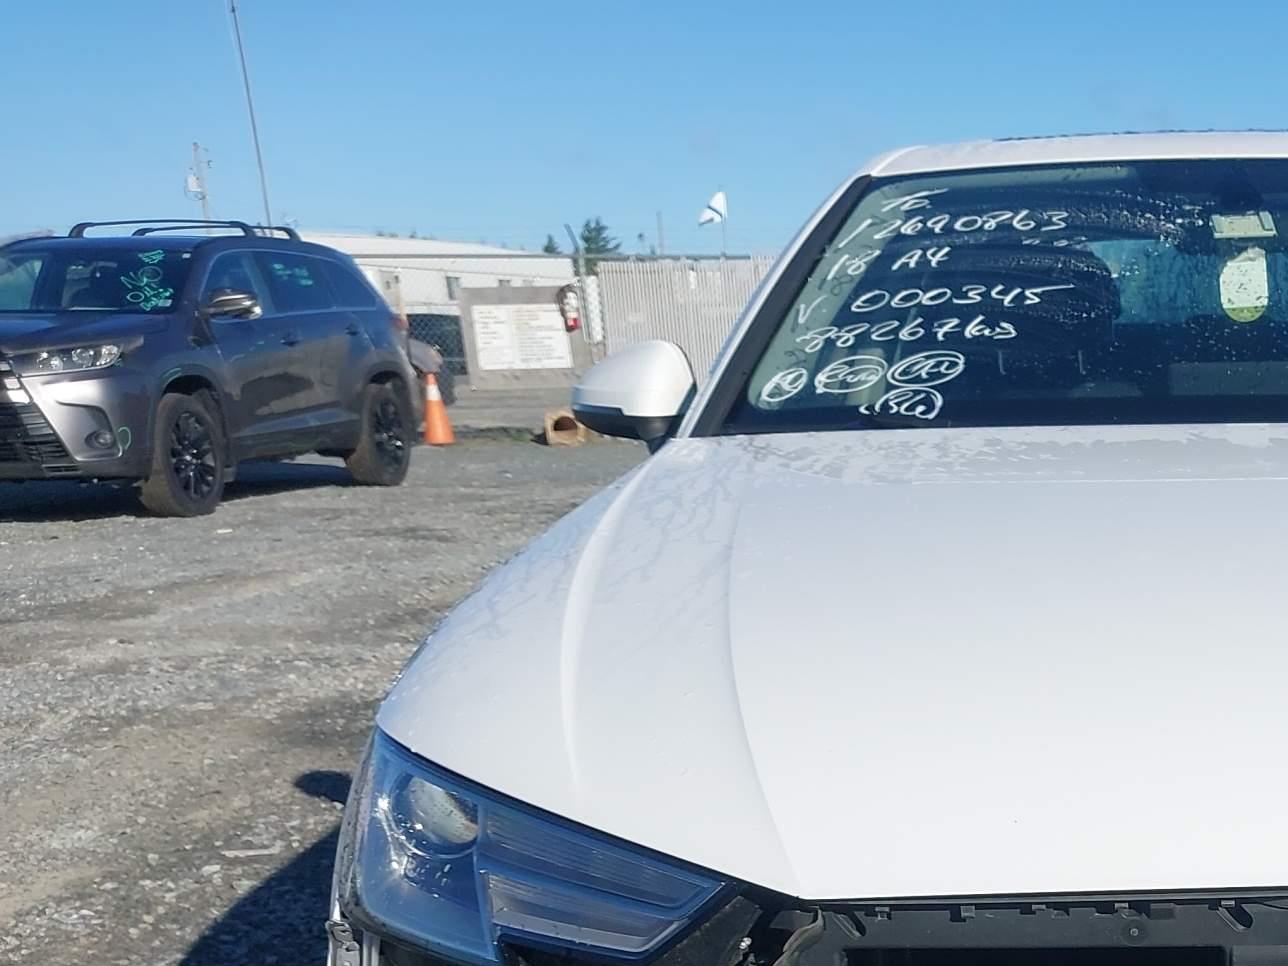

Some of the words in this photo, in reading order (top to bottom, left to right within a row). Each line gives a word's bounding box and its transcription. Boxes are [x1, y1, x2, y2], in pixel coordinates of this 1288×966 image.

[838, 209, 1069, 249] 12690863
[828, 249, 881, 281] 18
[891, 246, 951, 271] A4
[850, 283, 1075, 313] 000345
